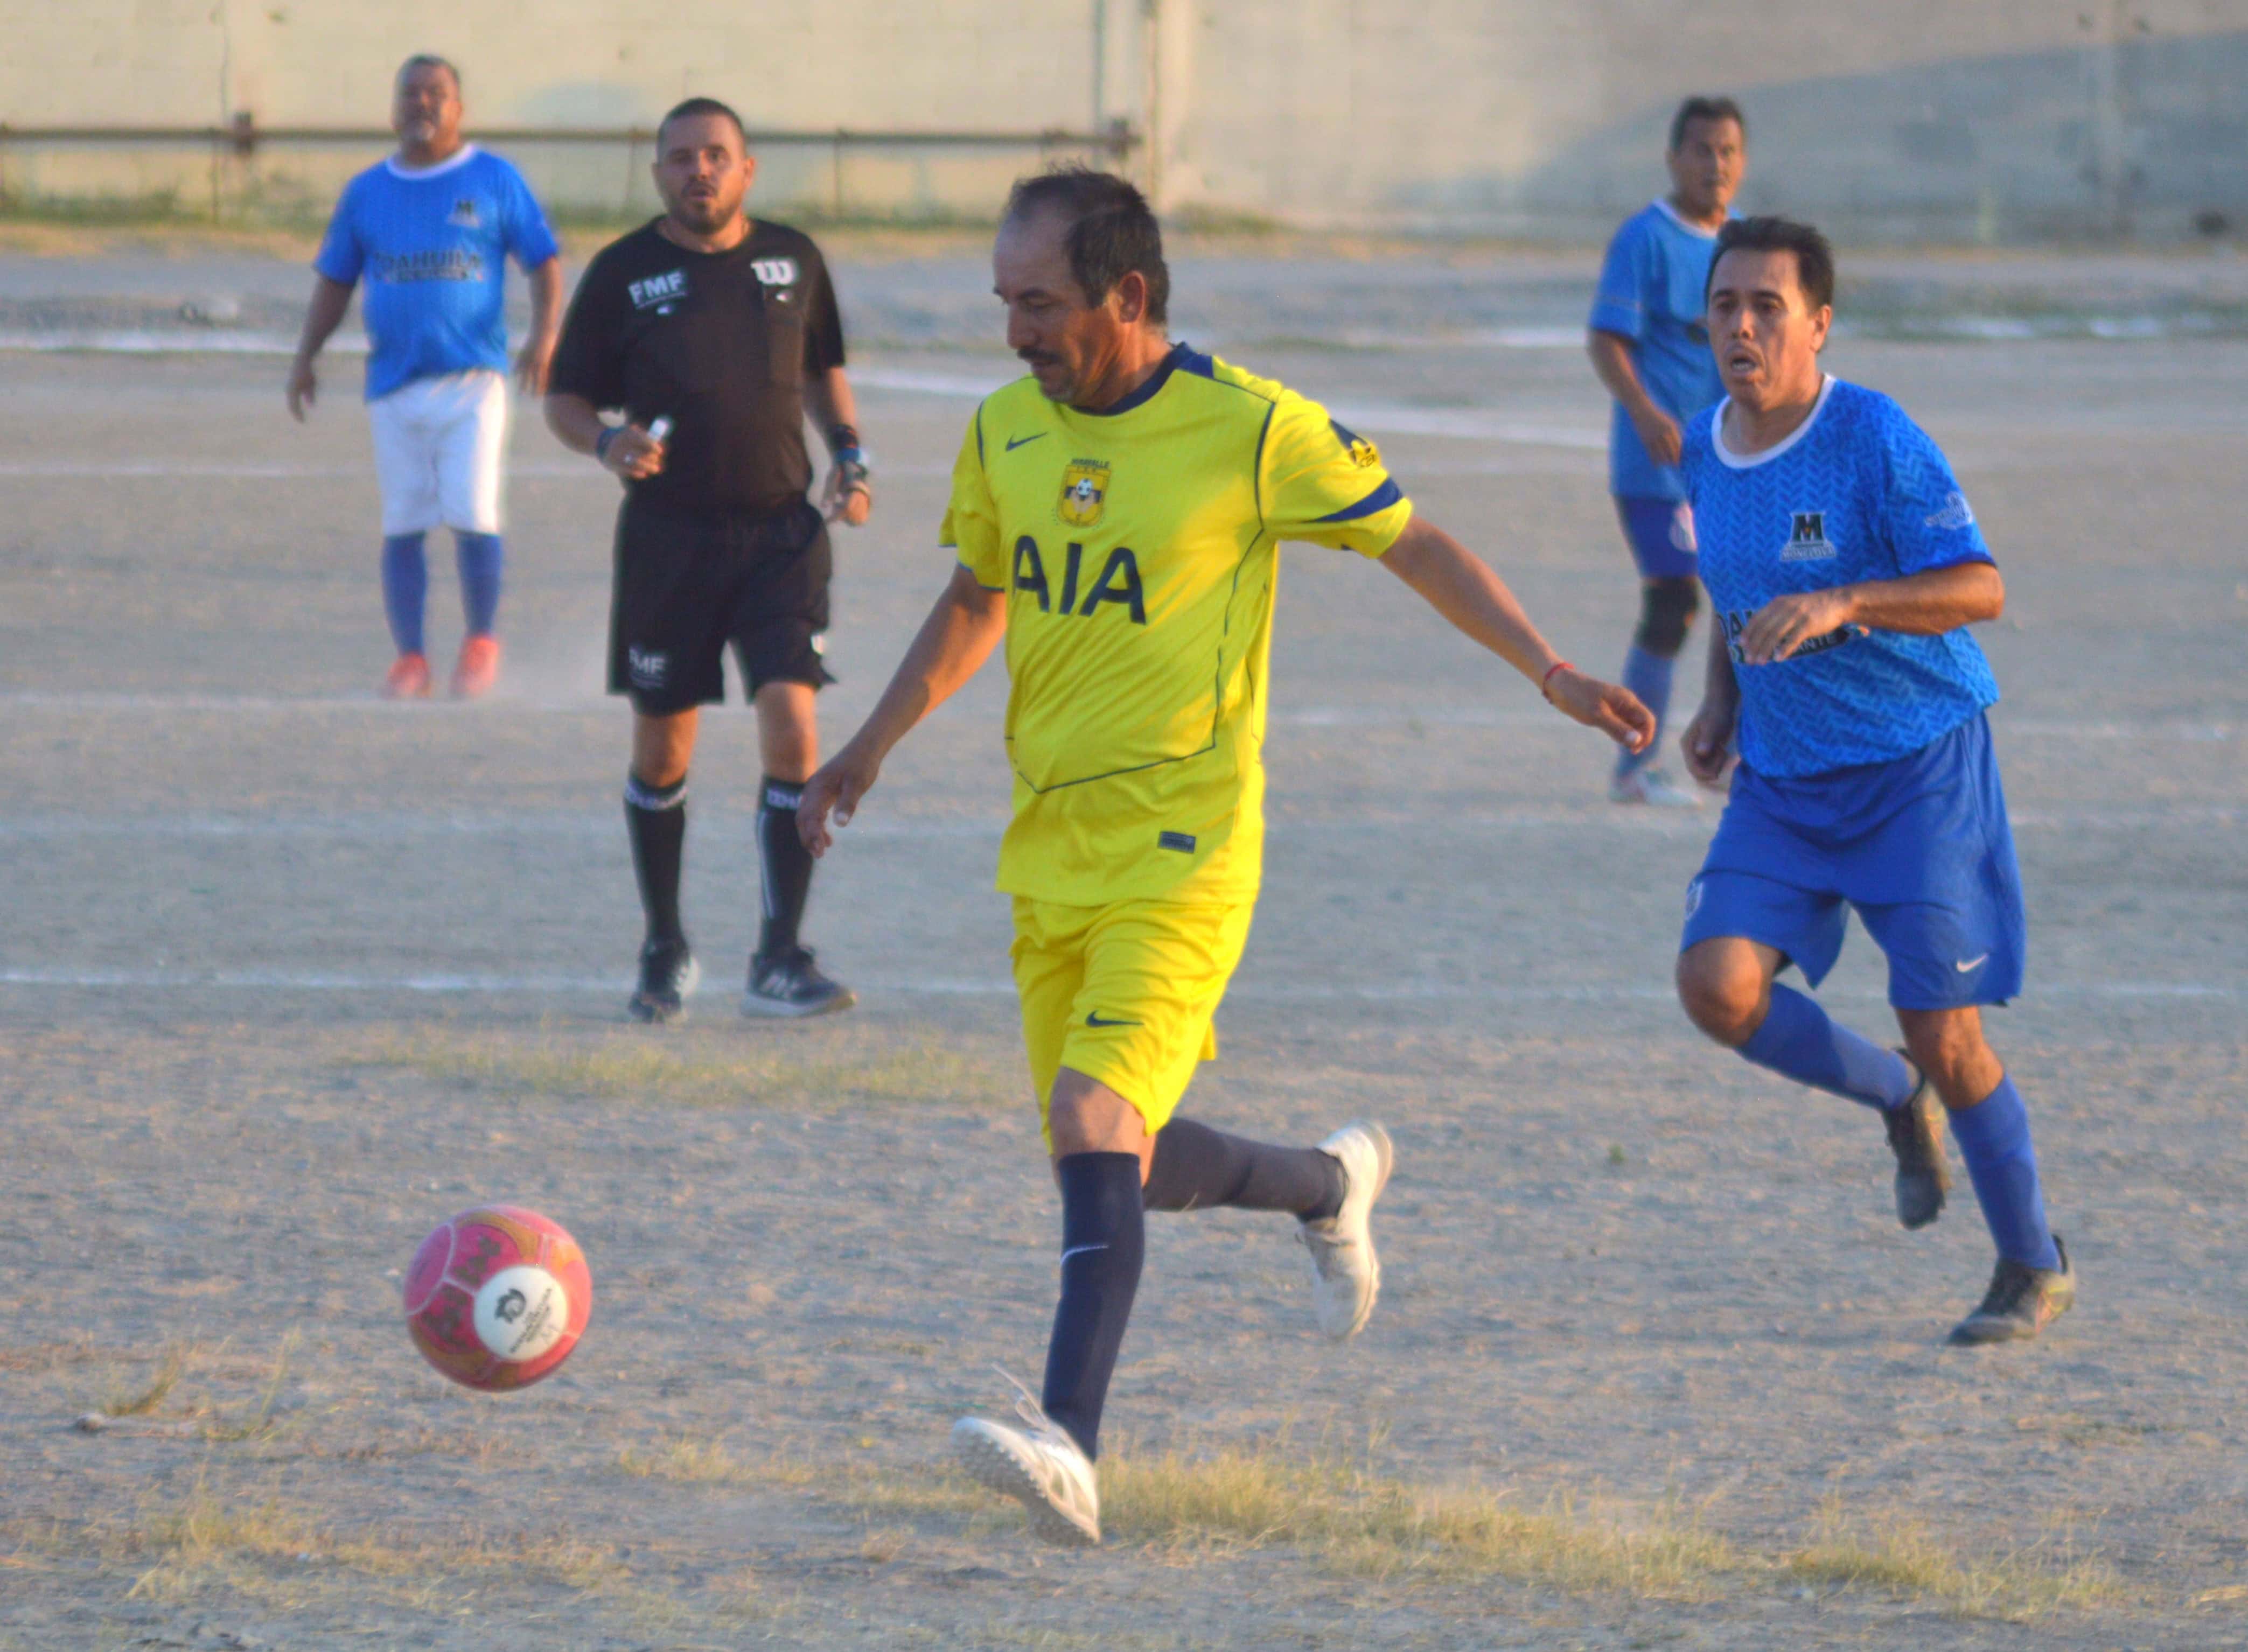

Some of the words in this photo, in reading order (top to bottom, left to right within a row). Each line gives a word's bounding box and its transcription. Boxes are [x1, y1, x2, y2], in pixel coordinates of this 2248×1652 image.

[628, 271, 685, 303] FMF
[1791, 514, 1823, 542] M
[1013, 535, 1146, 626] AIA
